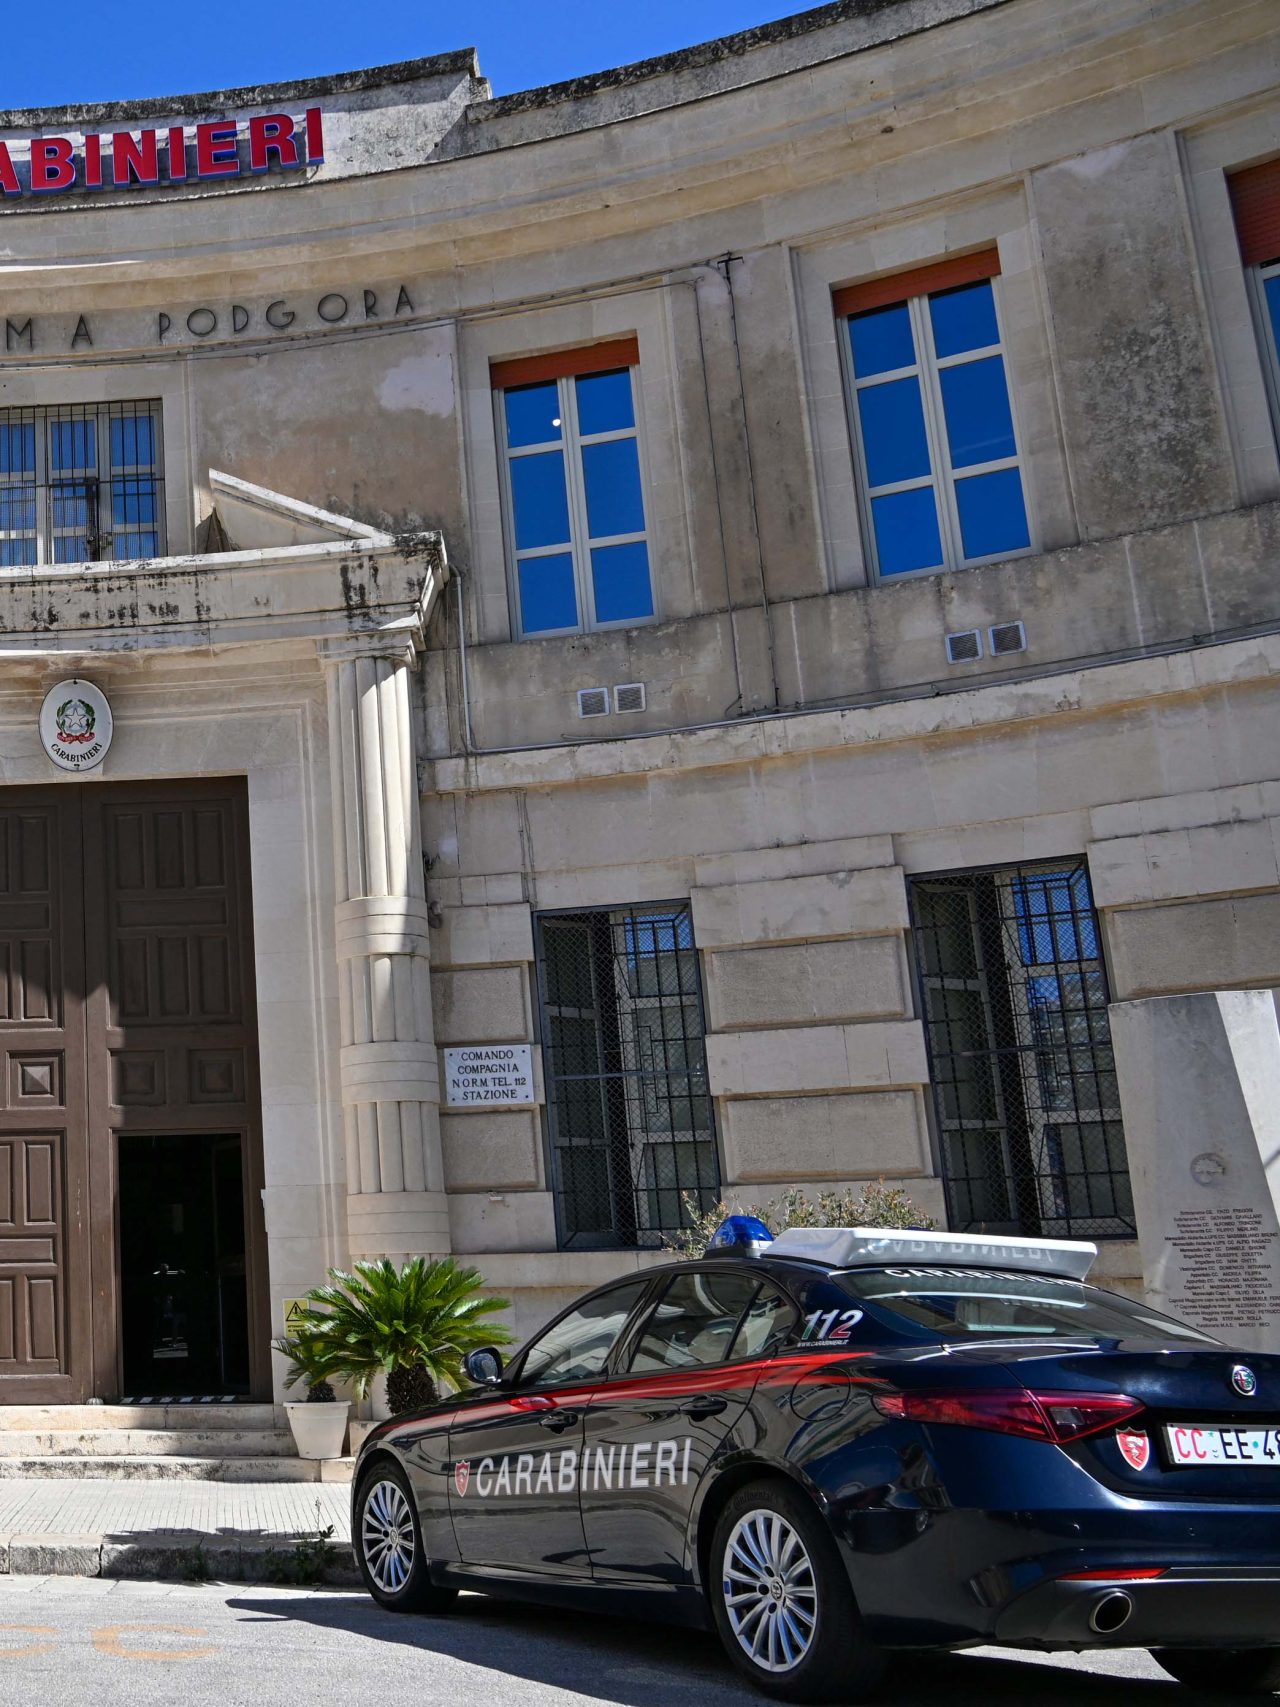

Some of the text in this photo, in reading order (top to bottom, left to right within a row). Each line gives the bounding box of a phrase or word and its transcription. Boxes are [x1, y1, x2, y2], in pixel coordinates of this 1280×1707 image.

[158, 285, 414, 341] PODGORA
[51, 743, 102, 762] CARABINIERI
[461, 1050, 514, 1061] COMANDO
[458, 1063, 519, 1074] COMPAGNIA
[514, 1077, 527, 1086] 112
[462, 1089, 517, 1100] STAZIONE
[801, 1309, 864, 1340] 112
[1174, 1427, 1207, 1459] CC
[1219, 1428, 1254, 1460] EE
[476, 1438, 691, 1497] CARABINIERI
